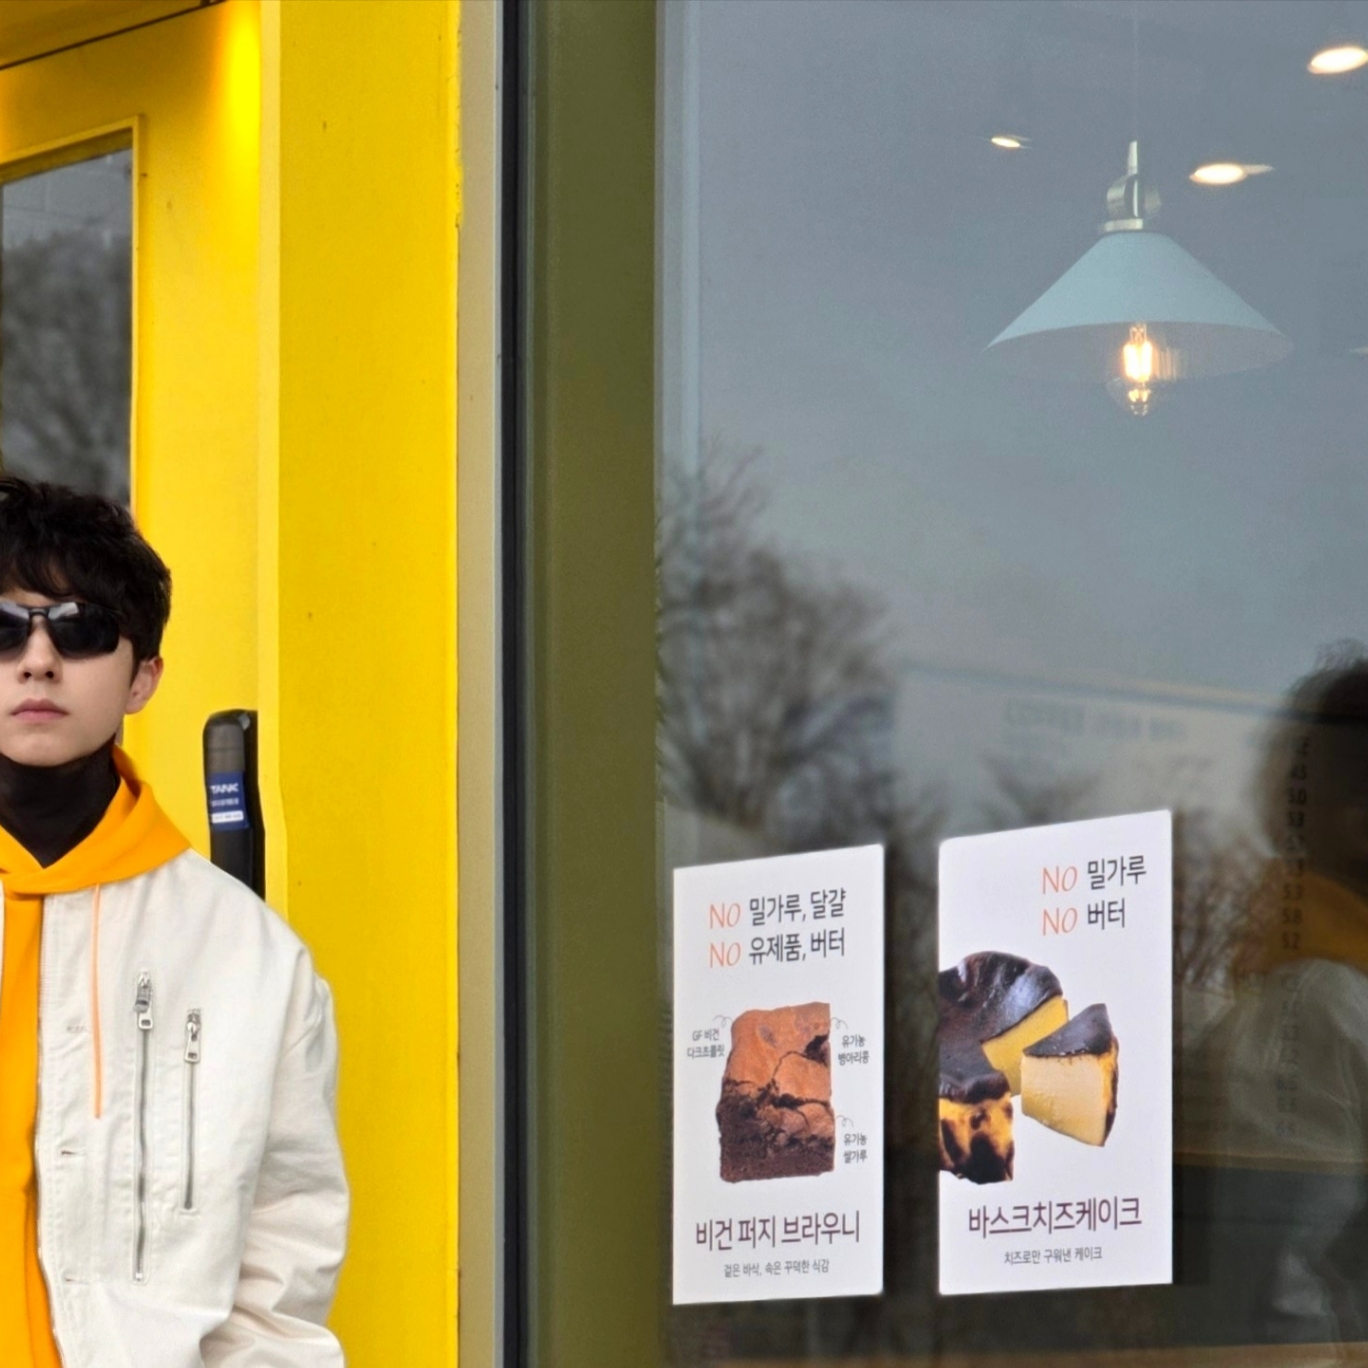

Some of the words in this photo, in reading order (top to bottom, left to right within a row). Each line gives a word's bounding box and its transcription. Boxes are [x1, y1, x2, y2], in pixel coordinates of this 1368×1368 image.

[1043, 865, 1078, 895] NO
[1087, 855, 1147, 890] 밀가루
[709, 902, 741, 930] NO
[749, 894, 806, 927] 밀가루,
[810, 887, 846, 920] 달걀
[1043, 907, 1078, 936] NO
[1087, 897, 1125, 931] 버터
[709, 941, 741, 969] NO
[749, 933, 806, 966] 유제품,
[810, 927, 845, 958] 버터
[704, 1028, 719, 1041] 비건
[696, 1218, 733, 1251] 비건
[738, 1215, 776, 1249] 퍼지
[781, 1210, 860, 1246] 브라우니
[969, 1196, 1142, 1239] 바스크치즈케이크
[812, 1258, 830, 1273] 식감
[1004, 1251, 1041, 1265] 치즈로만
[1043, 1248, 1072, 1264] 구워낸
[1074, 1247, 1103, 1261] 케이크
